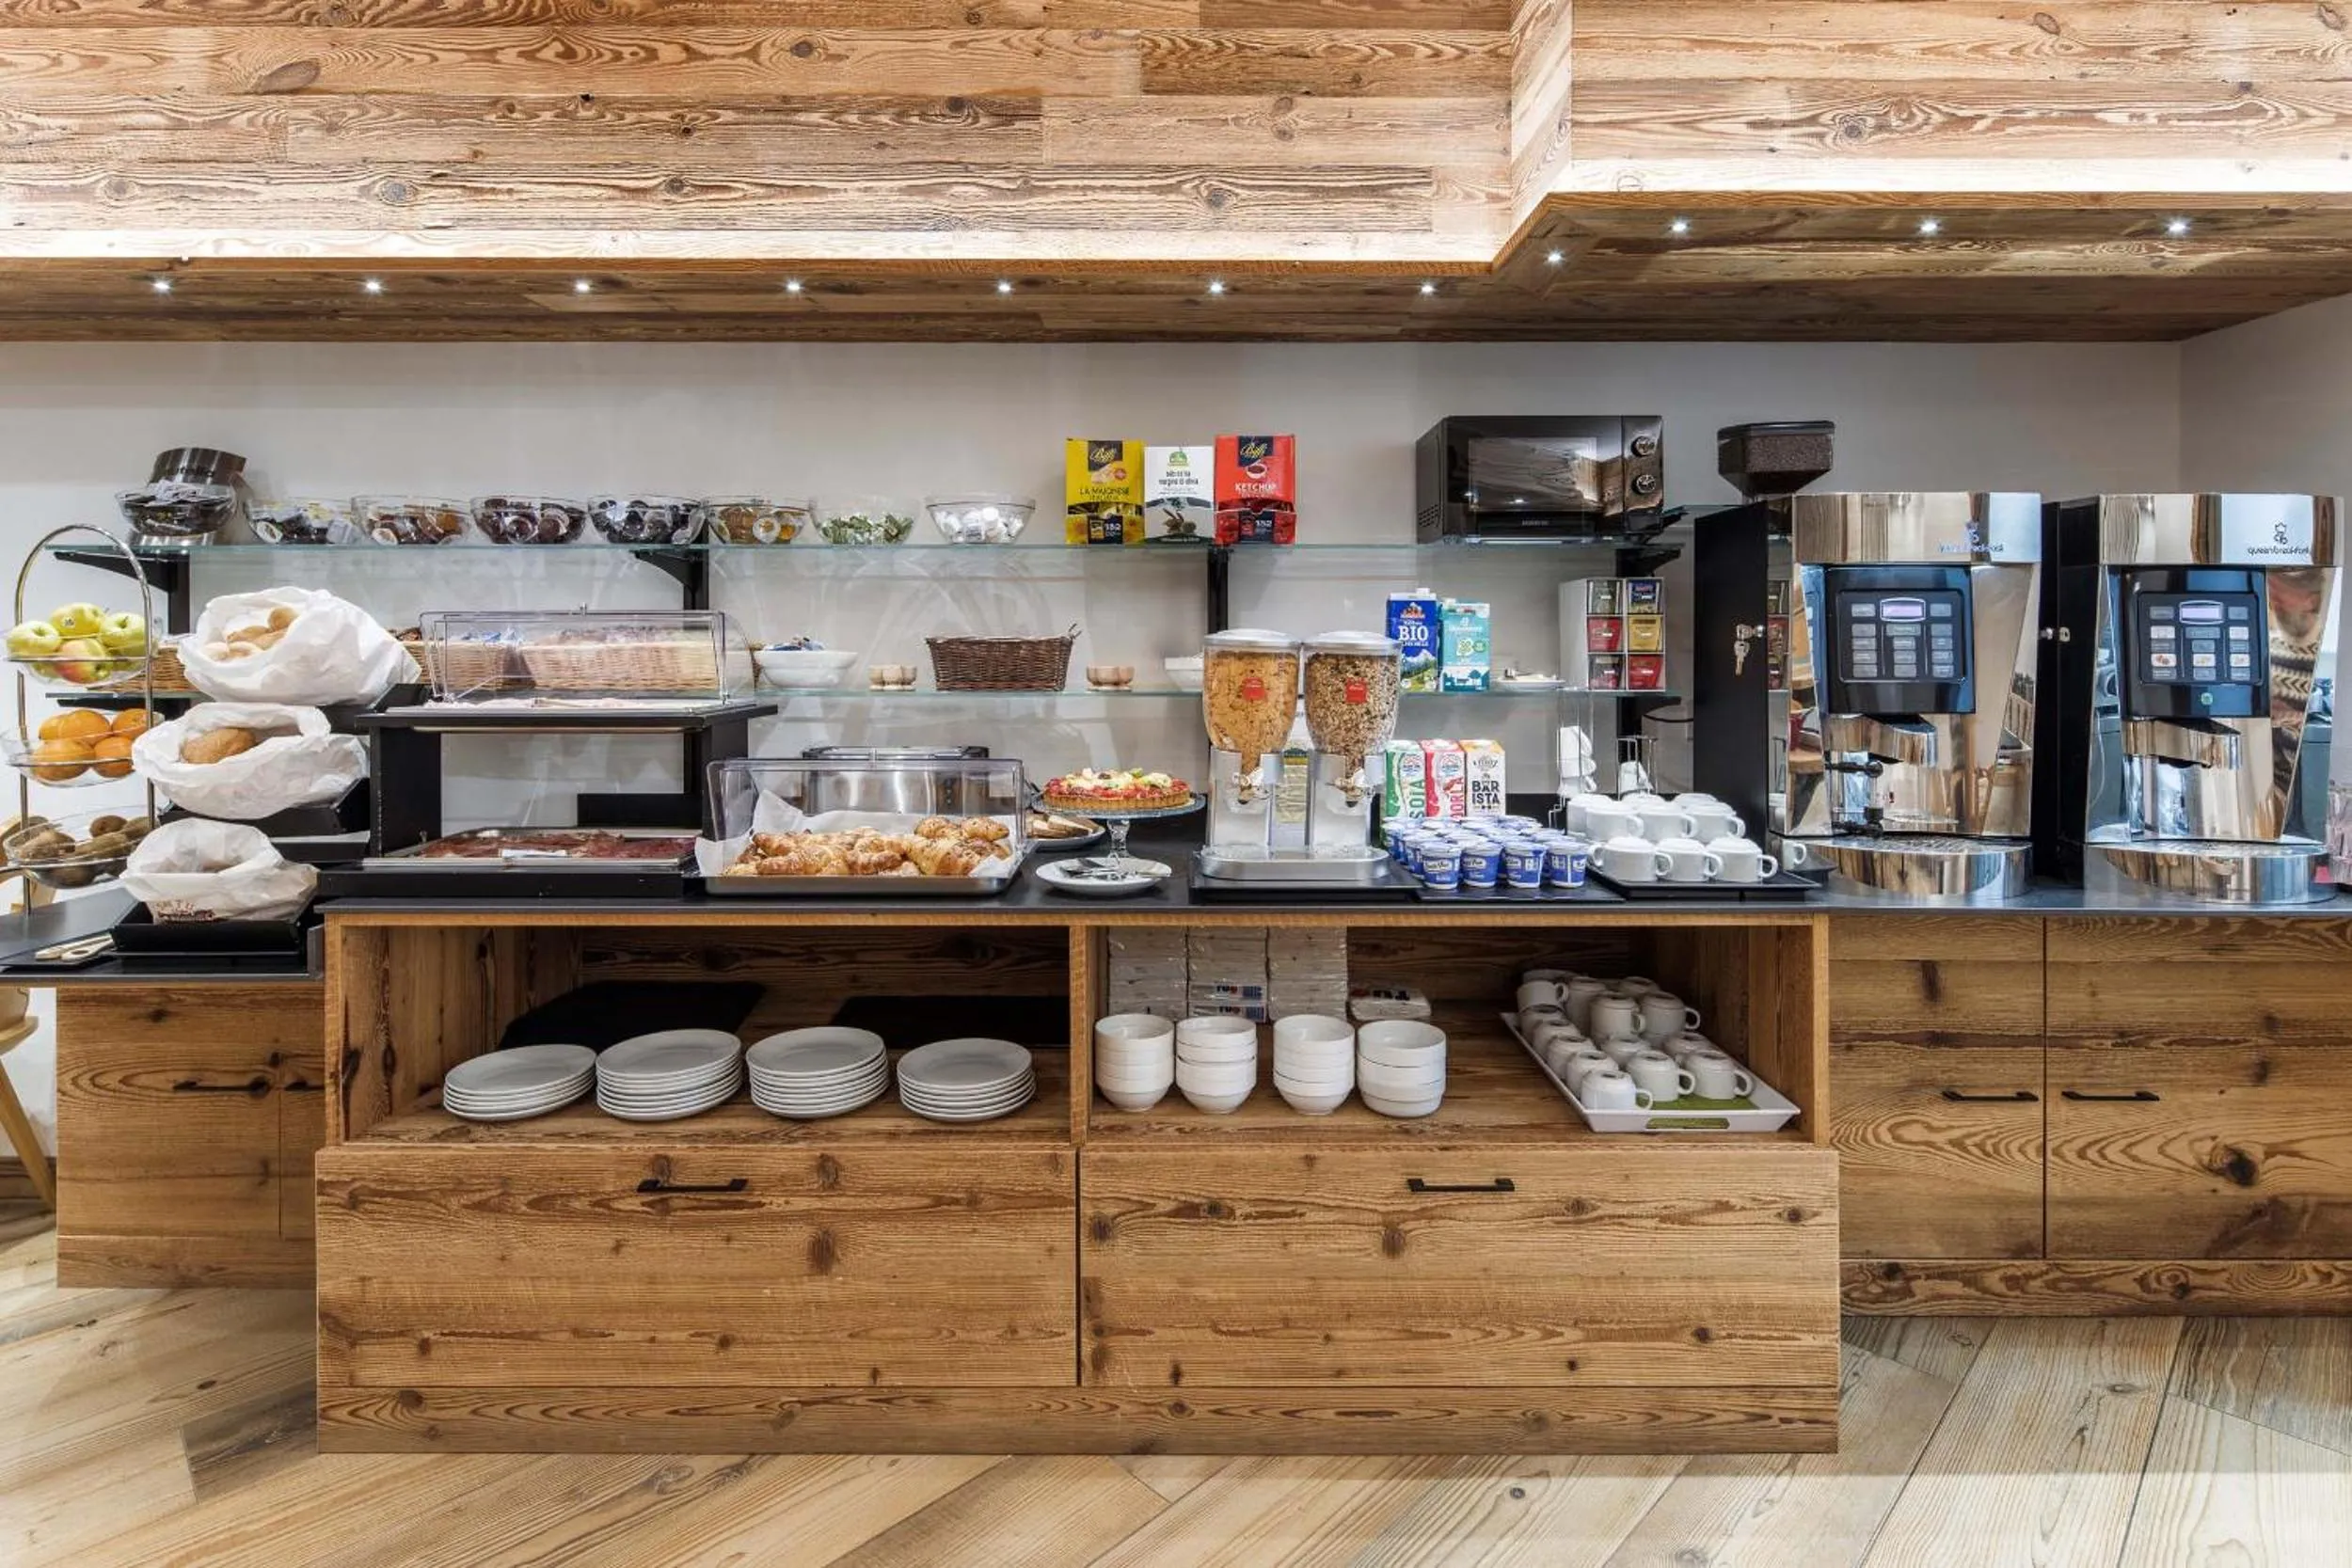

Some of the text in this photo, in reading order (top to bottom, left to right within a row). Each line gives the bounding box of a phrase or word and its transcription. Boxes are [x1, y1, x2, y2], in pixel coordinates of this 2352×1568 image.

[1398, 625, 1429, 641] BIO
[1471, 780, 1500, 792] BAR
[1471, 792, 1500, 805] ISTA
